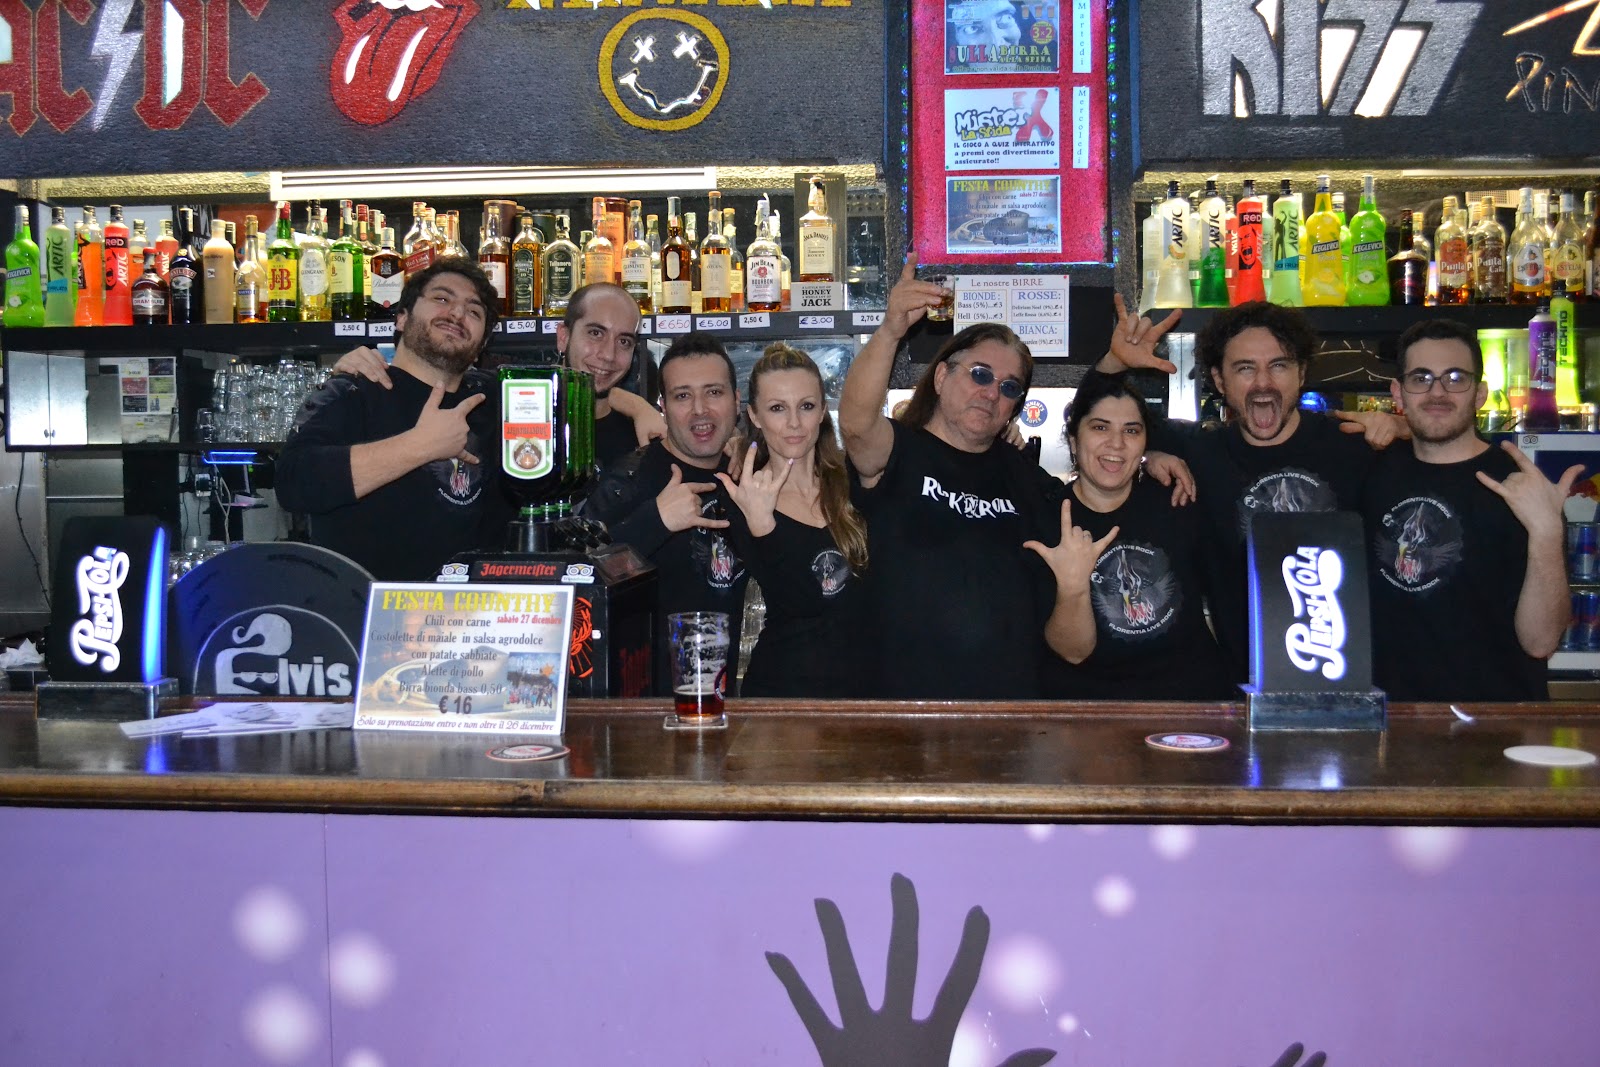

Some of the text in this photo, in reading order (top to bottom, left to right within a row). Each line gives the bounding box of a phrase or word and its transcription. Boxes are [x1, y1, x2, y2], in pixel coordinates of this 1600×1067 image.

[1000, 45, 1051, 56] BIRRA
[1200, 0, 1484, 118] KISS
[954, 106, 1032, 135] Mister
[961, 129, 977, 141] La
[953, 179, 1051, 192] FESTA COUNTRY
[1172, 208, 1183, 248] ARTIC
[1209, 210, 1220, 248] ARTIC
[1288, 209, 1299, 252] ARTIC
[1353, 242, 1383, 254] KEGLEVICH
[52, 236, 64, 277] ARTIC
[117, 252, 129, 287] ARTIC
[750, 259, 775, 270] JIM BEAM
[971, 278, 1044, 287] Le nostre BIRRE
[1018, 290, 1061, 300] ROSSE:
[801, 298, 832, 307] JACK
[342, 324, 355, 332] 2,50
[1019, 325, 1058, 335] BIANCA:
[1558, 310, 1568, 366] TECHNO
[1028, 408, 1039, 419] T
[1250, 473, 1284, 493] FLORENTIA
[1300, 474, 1320, 488] ROCK
[1436, 502, 1452, 519] ROCK
[1135, 546, 1155, 556] ROCK
[1421, 577, 1440, 590] ROCK
[382, 591, 557, 613] FESTA COUNTRY
[425, 614, 563, 627] Chili con carne sabato 27 dicembre
[1109, 607, 1174, 635] FLORENTIA LIVE ROCK
[371, 630, 544, 646] Costolette di maiale in salsa agrodolce
[411, 651, 427, 659] con
[429, 650, 458, 661] patate
[460, 648, 498, 661] sabbiate
[421, 665, 484, 679] Alette di pollo
[399, 681, 503, 695] Birra bionda bass 0,50
[439, 695, 473, 715] € 16
[356, 715, 376, 726] Solo
[387, 718, 435, 729] prenotazione
[436, 720, 456, 728] entro
[479, 721, 497, 729] oltre
[498, 721, 505, 729] il
[505, 720, 520, 730] 26
[519, 722, 555, 731] dicembre
